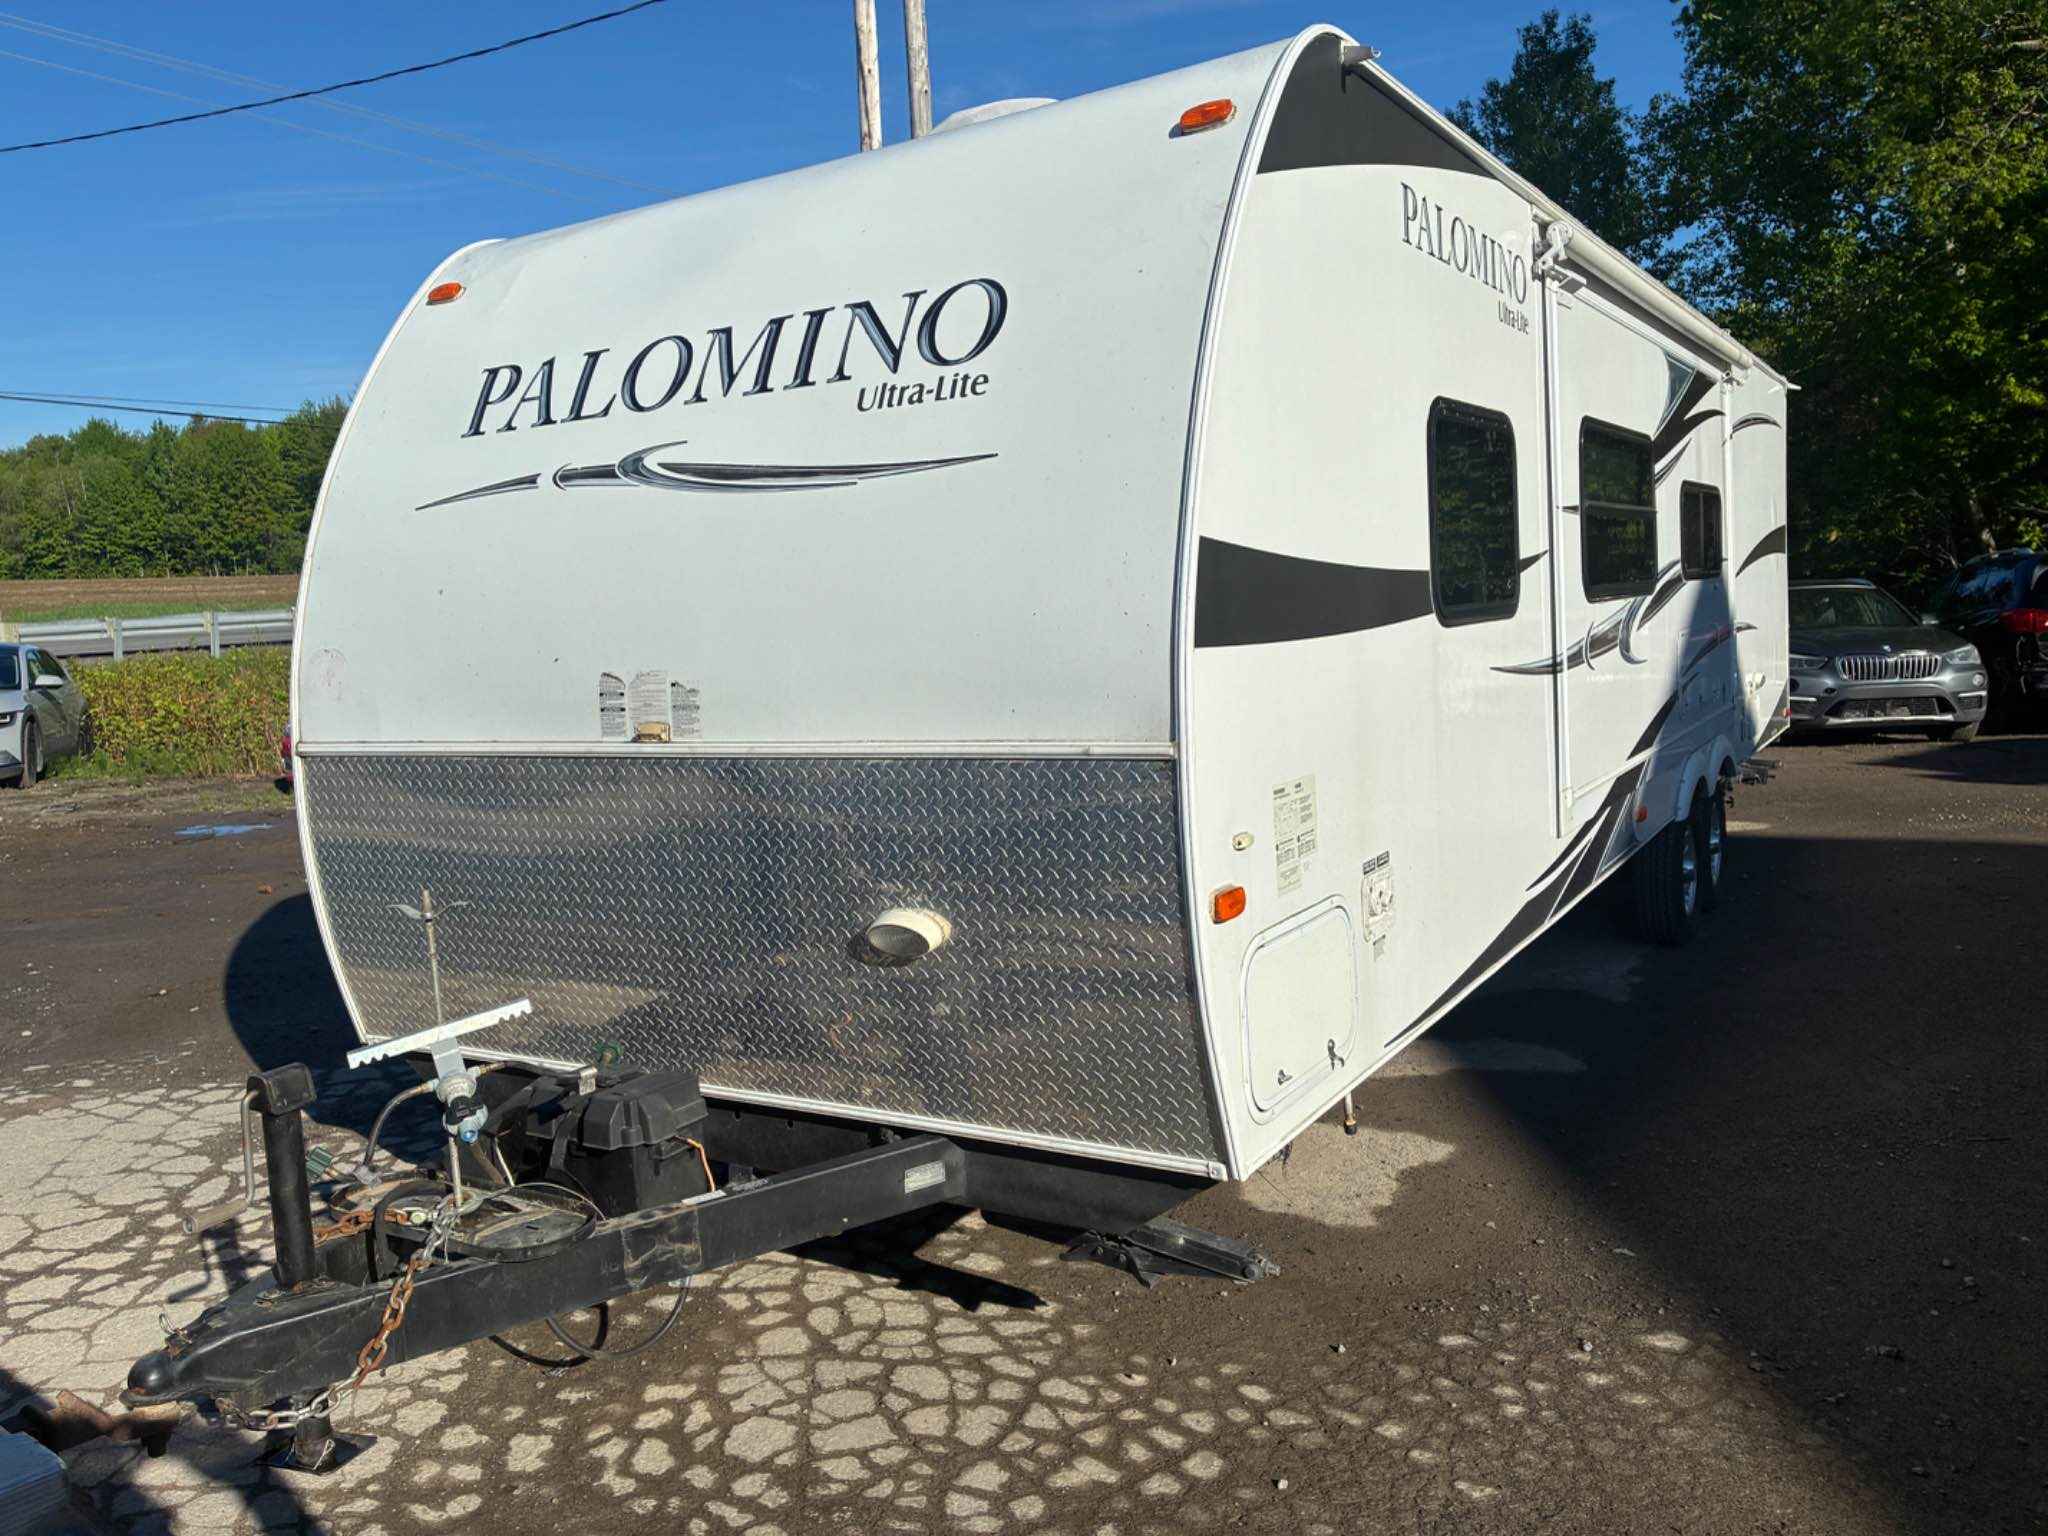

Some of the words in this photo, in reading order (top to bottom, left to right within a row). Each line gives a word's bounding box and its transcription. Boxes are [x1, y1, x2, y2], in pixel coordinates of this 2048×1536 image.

[1401, 182, 1527, 305] PALOMINO
[461, 277, 1008, 438] PALOMINO
[857, 373, 989, 413] Ultra-Lite
